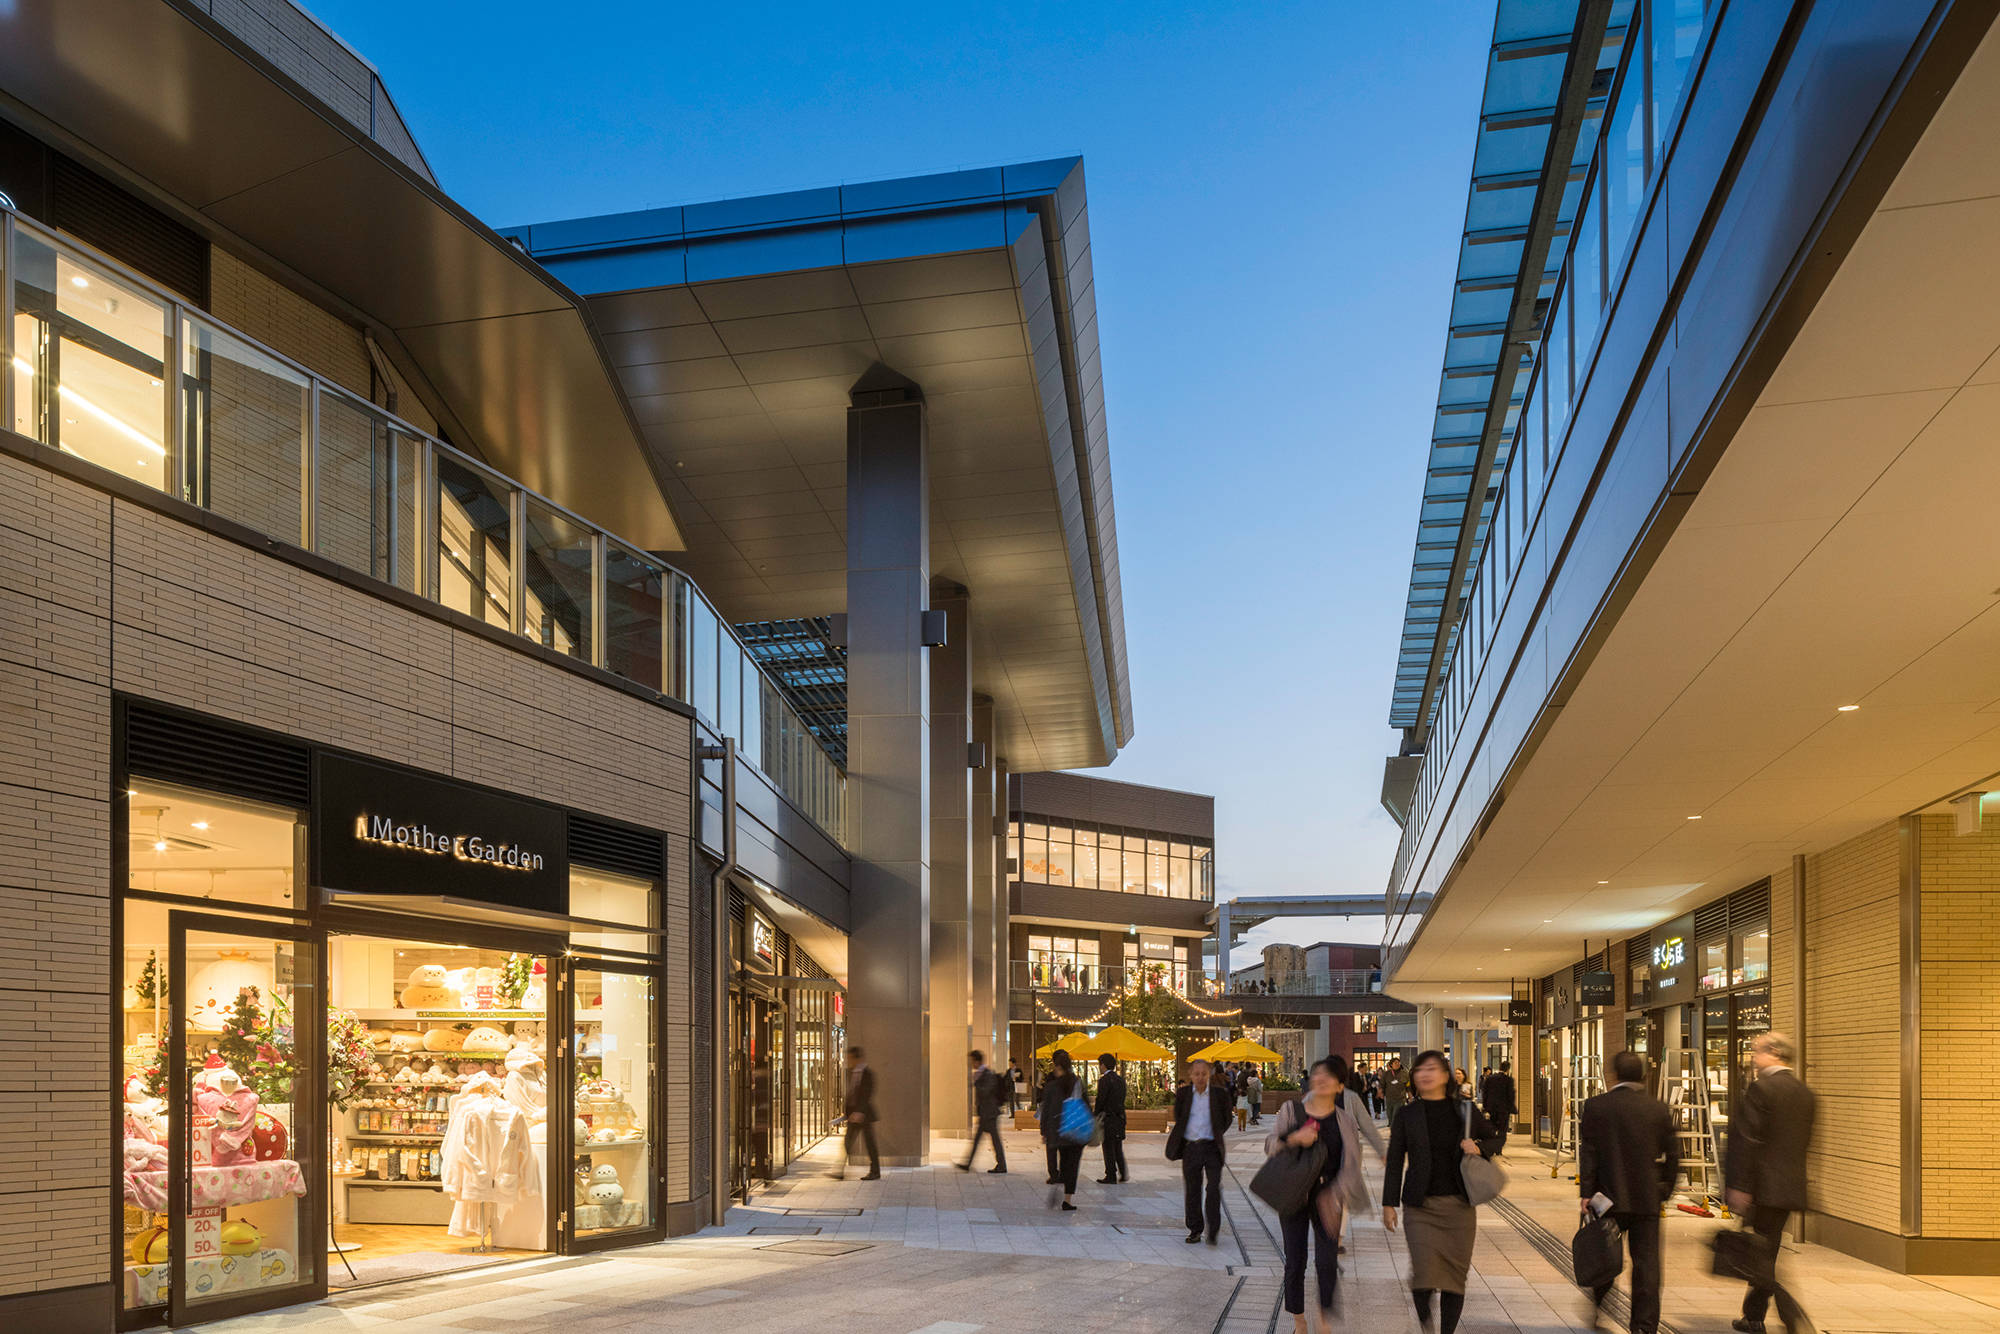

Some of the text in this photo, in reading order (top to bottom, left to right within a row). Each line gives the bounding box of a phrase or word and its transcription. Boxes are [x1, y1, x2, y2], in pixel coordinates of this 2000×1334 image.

[373, 815, 543, 870] Mother Garden
[1512, 1009, 1528, 1017] Style
[204, 1207, 219, 1216] OFF
